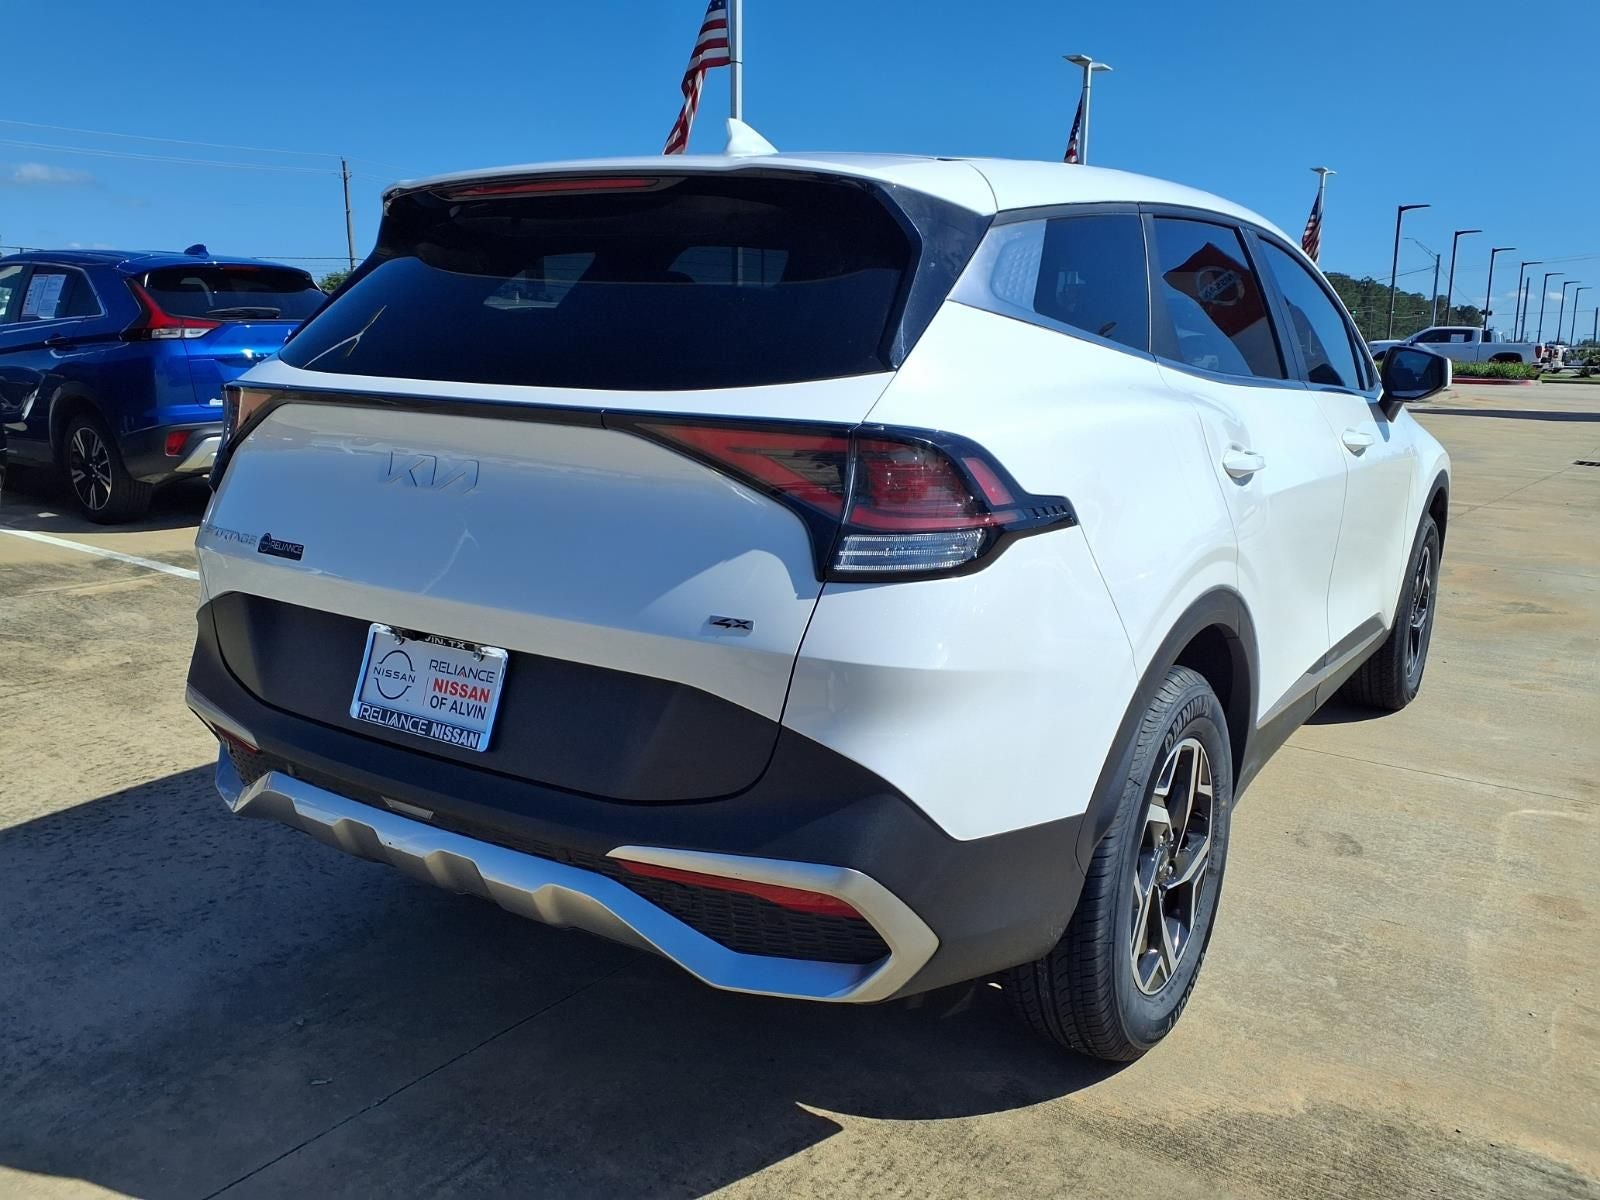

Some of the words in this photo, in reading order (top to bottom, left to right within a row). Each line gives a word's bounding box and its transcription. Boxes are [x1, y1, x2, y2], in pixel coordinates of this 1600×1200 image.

[271, 540, 303, 554] RELIANCE
[448, 640, 466, 650] TX
[373, 666, 416, 684] NISSAN
[429, 659, 496, 684] RELIANCE
[432, 677, 491, 703] NISSAN
[429, 695, 447, 710] OF
[448, 700, 487, 721] ALVIN
[360, 705, 427, 734] RELIANCE
[429, 722, 480, 749] NISSAN
